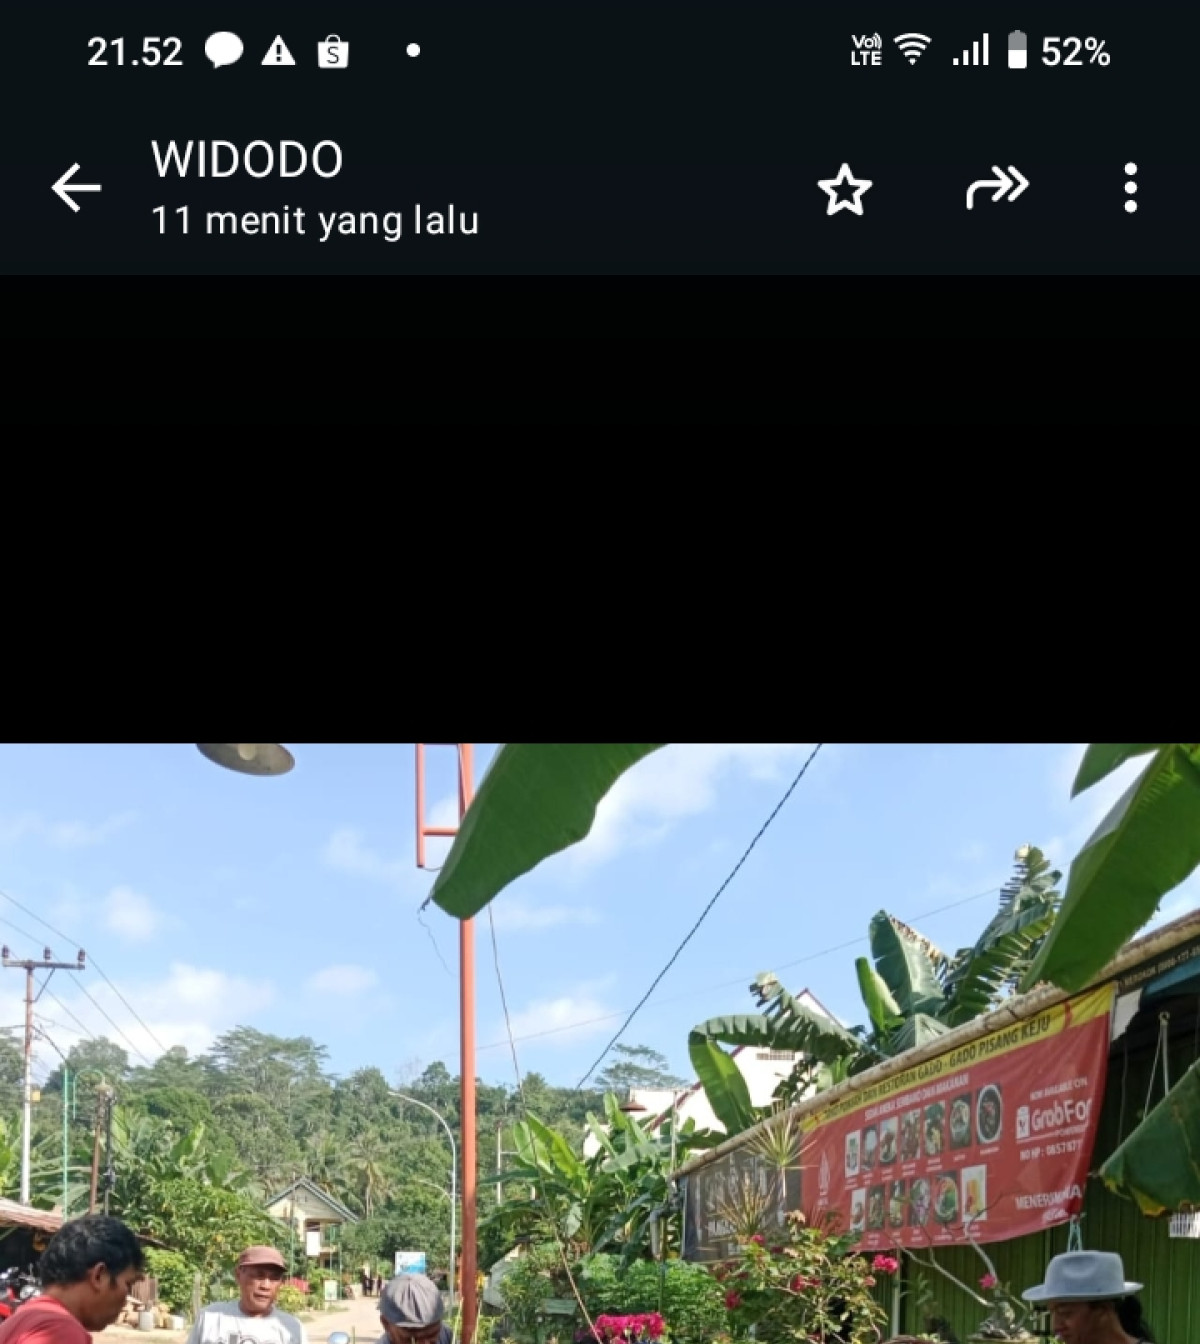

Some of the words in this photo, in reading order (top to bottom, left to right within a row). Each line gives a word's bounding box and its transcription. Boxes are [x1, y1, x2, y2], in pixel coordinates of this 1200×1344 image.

[949, 1044, 977, 1068] GADO
[978, 1027, 1018, 1056] PISANG
[1021, 1014, 1051, 1040] KEJU
